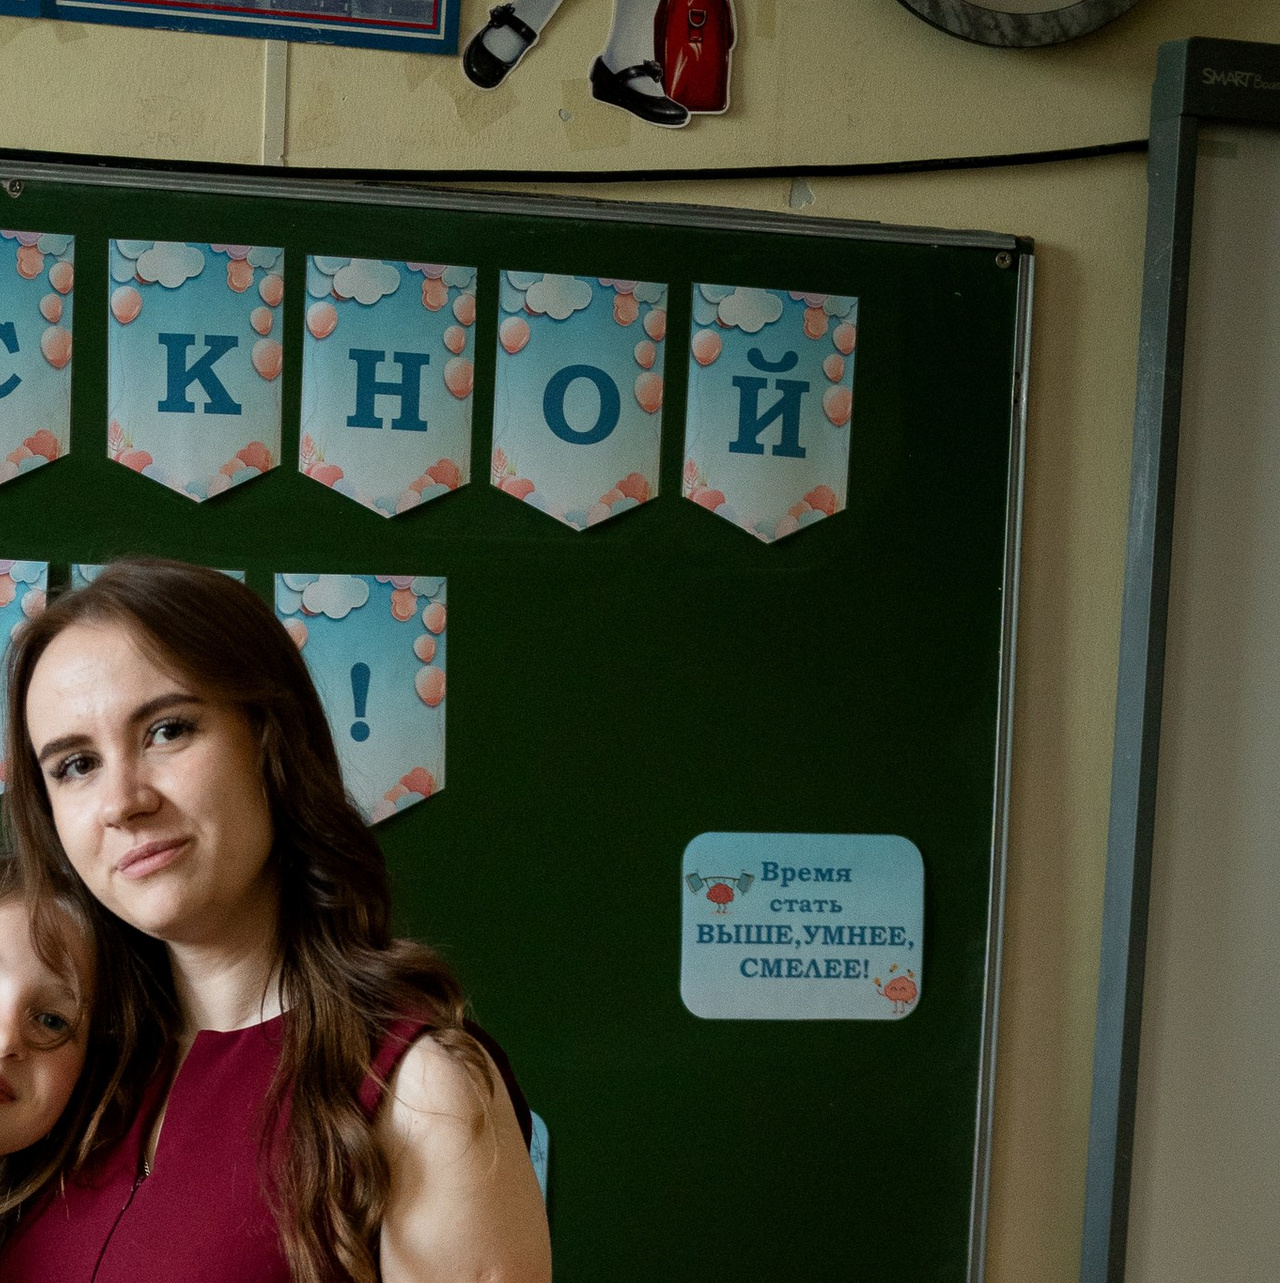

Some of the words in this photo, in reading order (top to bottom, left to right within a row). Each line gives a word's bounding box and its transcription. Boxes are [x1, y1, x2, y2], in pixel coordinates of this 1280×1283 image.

[1202, 67, 1254, 87] SMART
[760, 860, 852, 888] Время
[769, 898, 843, 914] стать
[739, 957, 870, 980] СМЕЛЕЕ!
